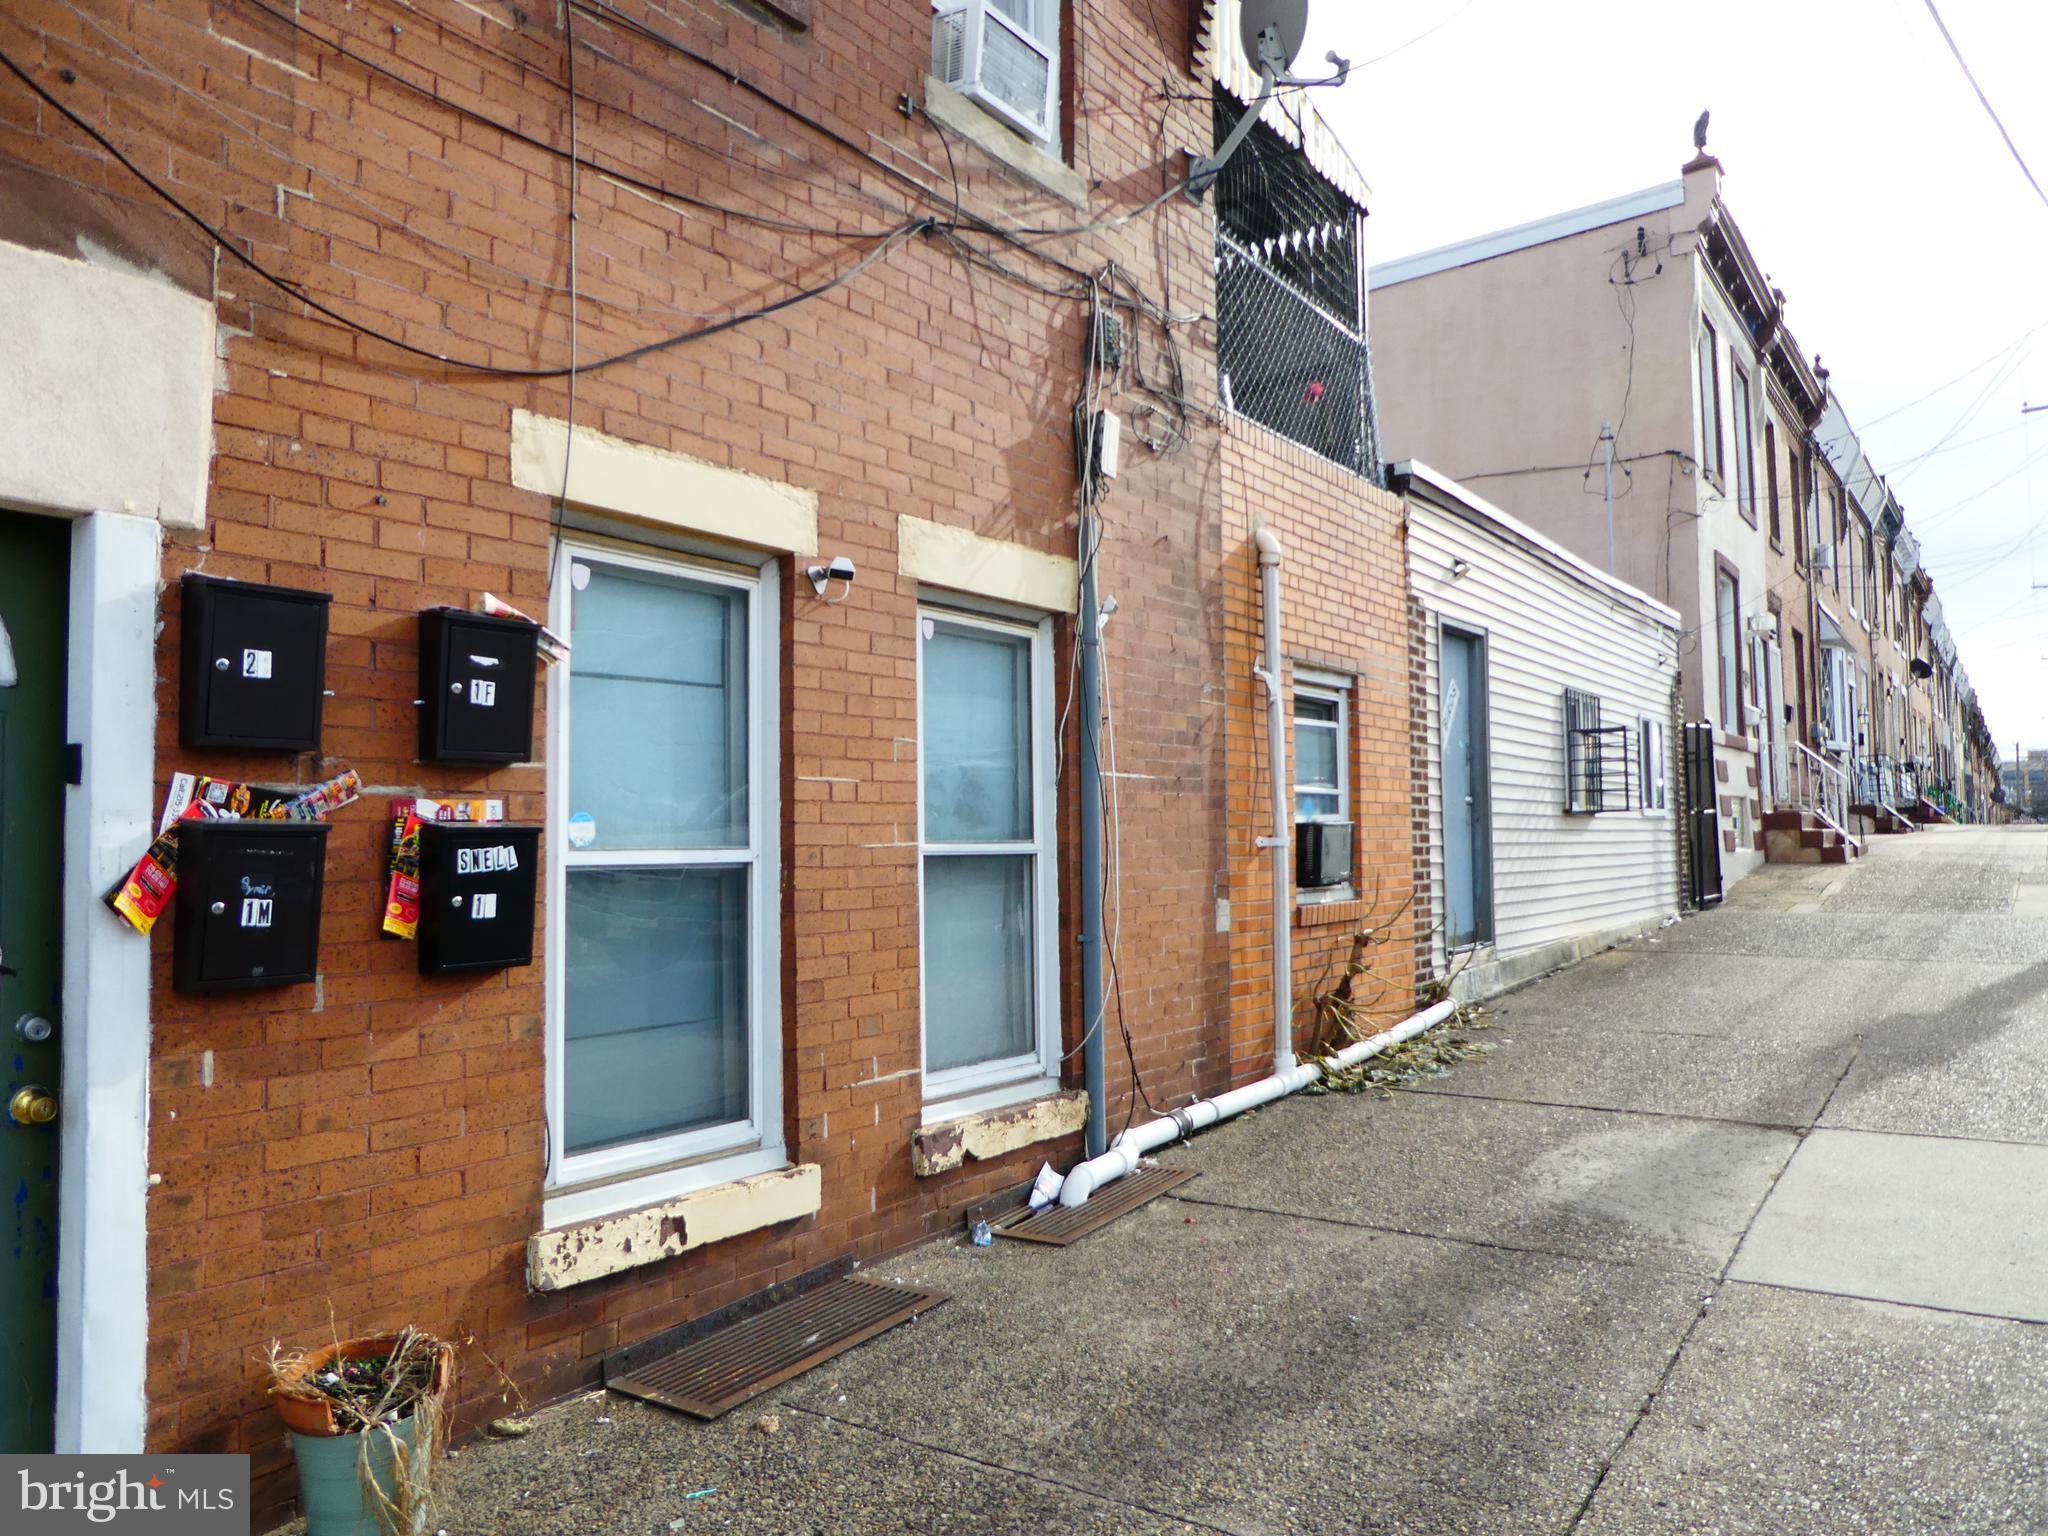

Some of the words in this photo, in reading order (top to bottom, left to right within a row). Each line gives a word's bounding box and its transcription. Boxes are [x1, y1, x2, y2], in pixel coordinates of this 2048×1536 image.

[245, 651, 256, 675] 2
[474, 682, 494, 704] 1F
[459, 846, 518, 872] SNELL
[246, 899, 271, 925] 1M
